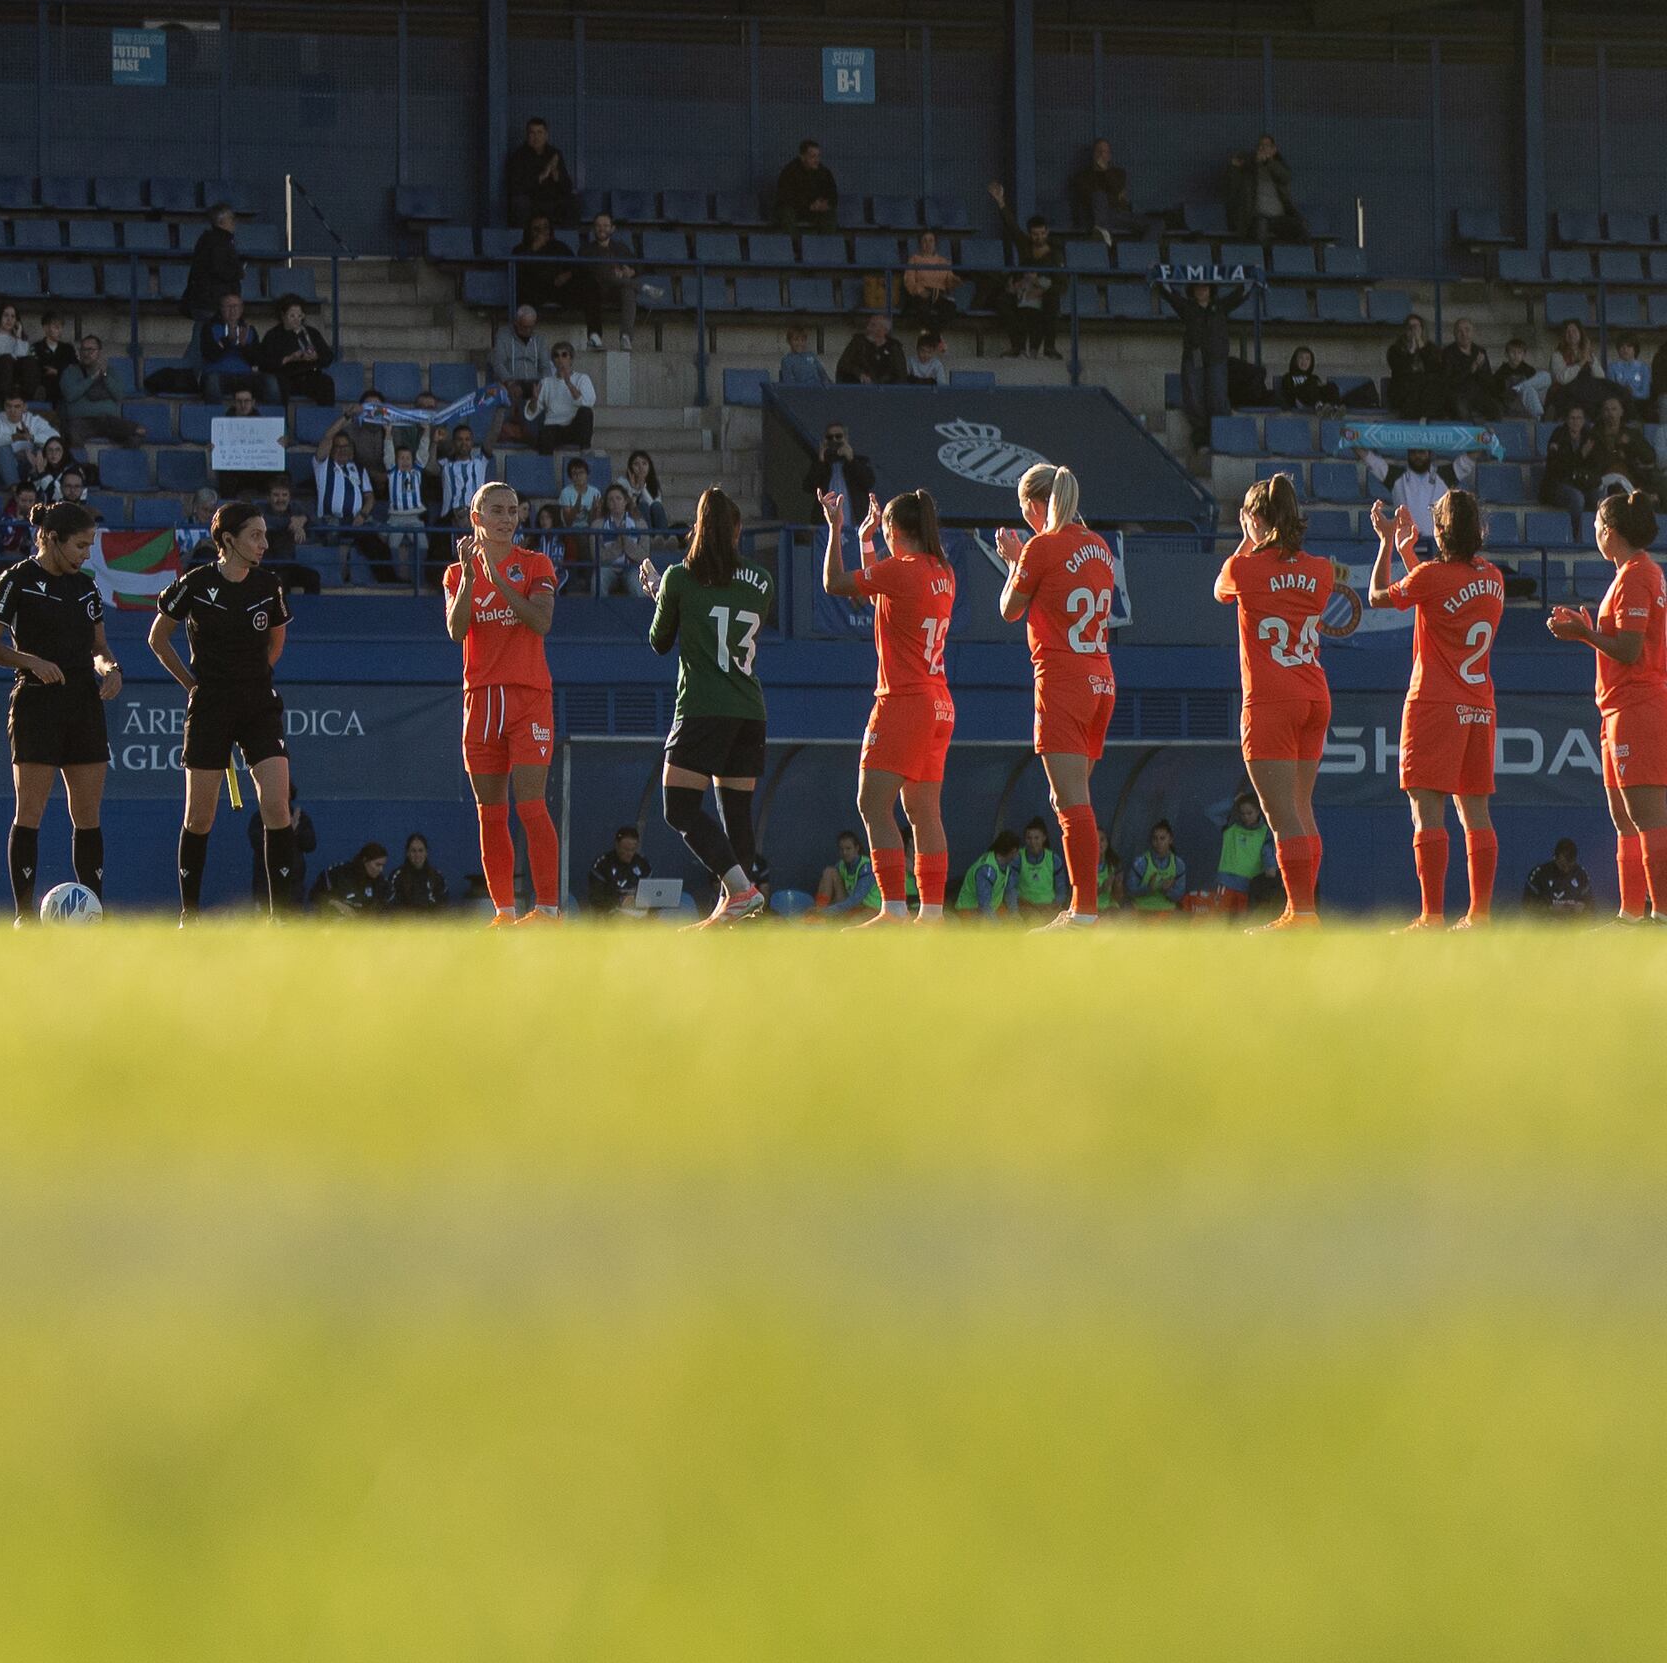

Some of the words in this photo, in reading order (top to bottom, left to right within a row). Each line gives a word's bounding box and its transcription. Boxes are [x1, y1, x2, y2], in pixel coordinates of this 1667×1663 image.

[113, 46, 151, 58] FUTBOL
[832, 51, 865, 65] SECTOR
[113, 59, 139, 72] BASE
[836, 68, 861, 93] B-1
[1269, 574, 1317, 593] AIARA
[475, 606, 515, 624] Halcó
[1066, 587, 1112, 654] 22
[709, 606, 761, 677] 13
[1258, 615, 1322, 669] 24
[1459, 621, 1493, 684] 2
